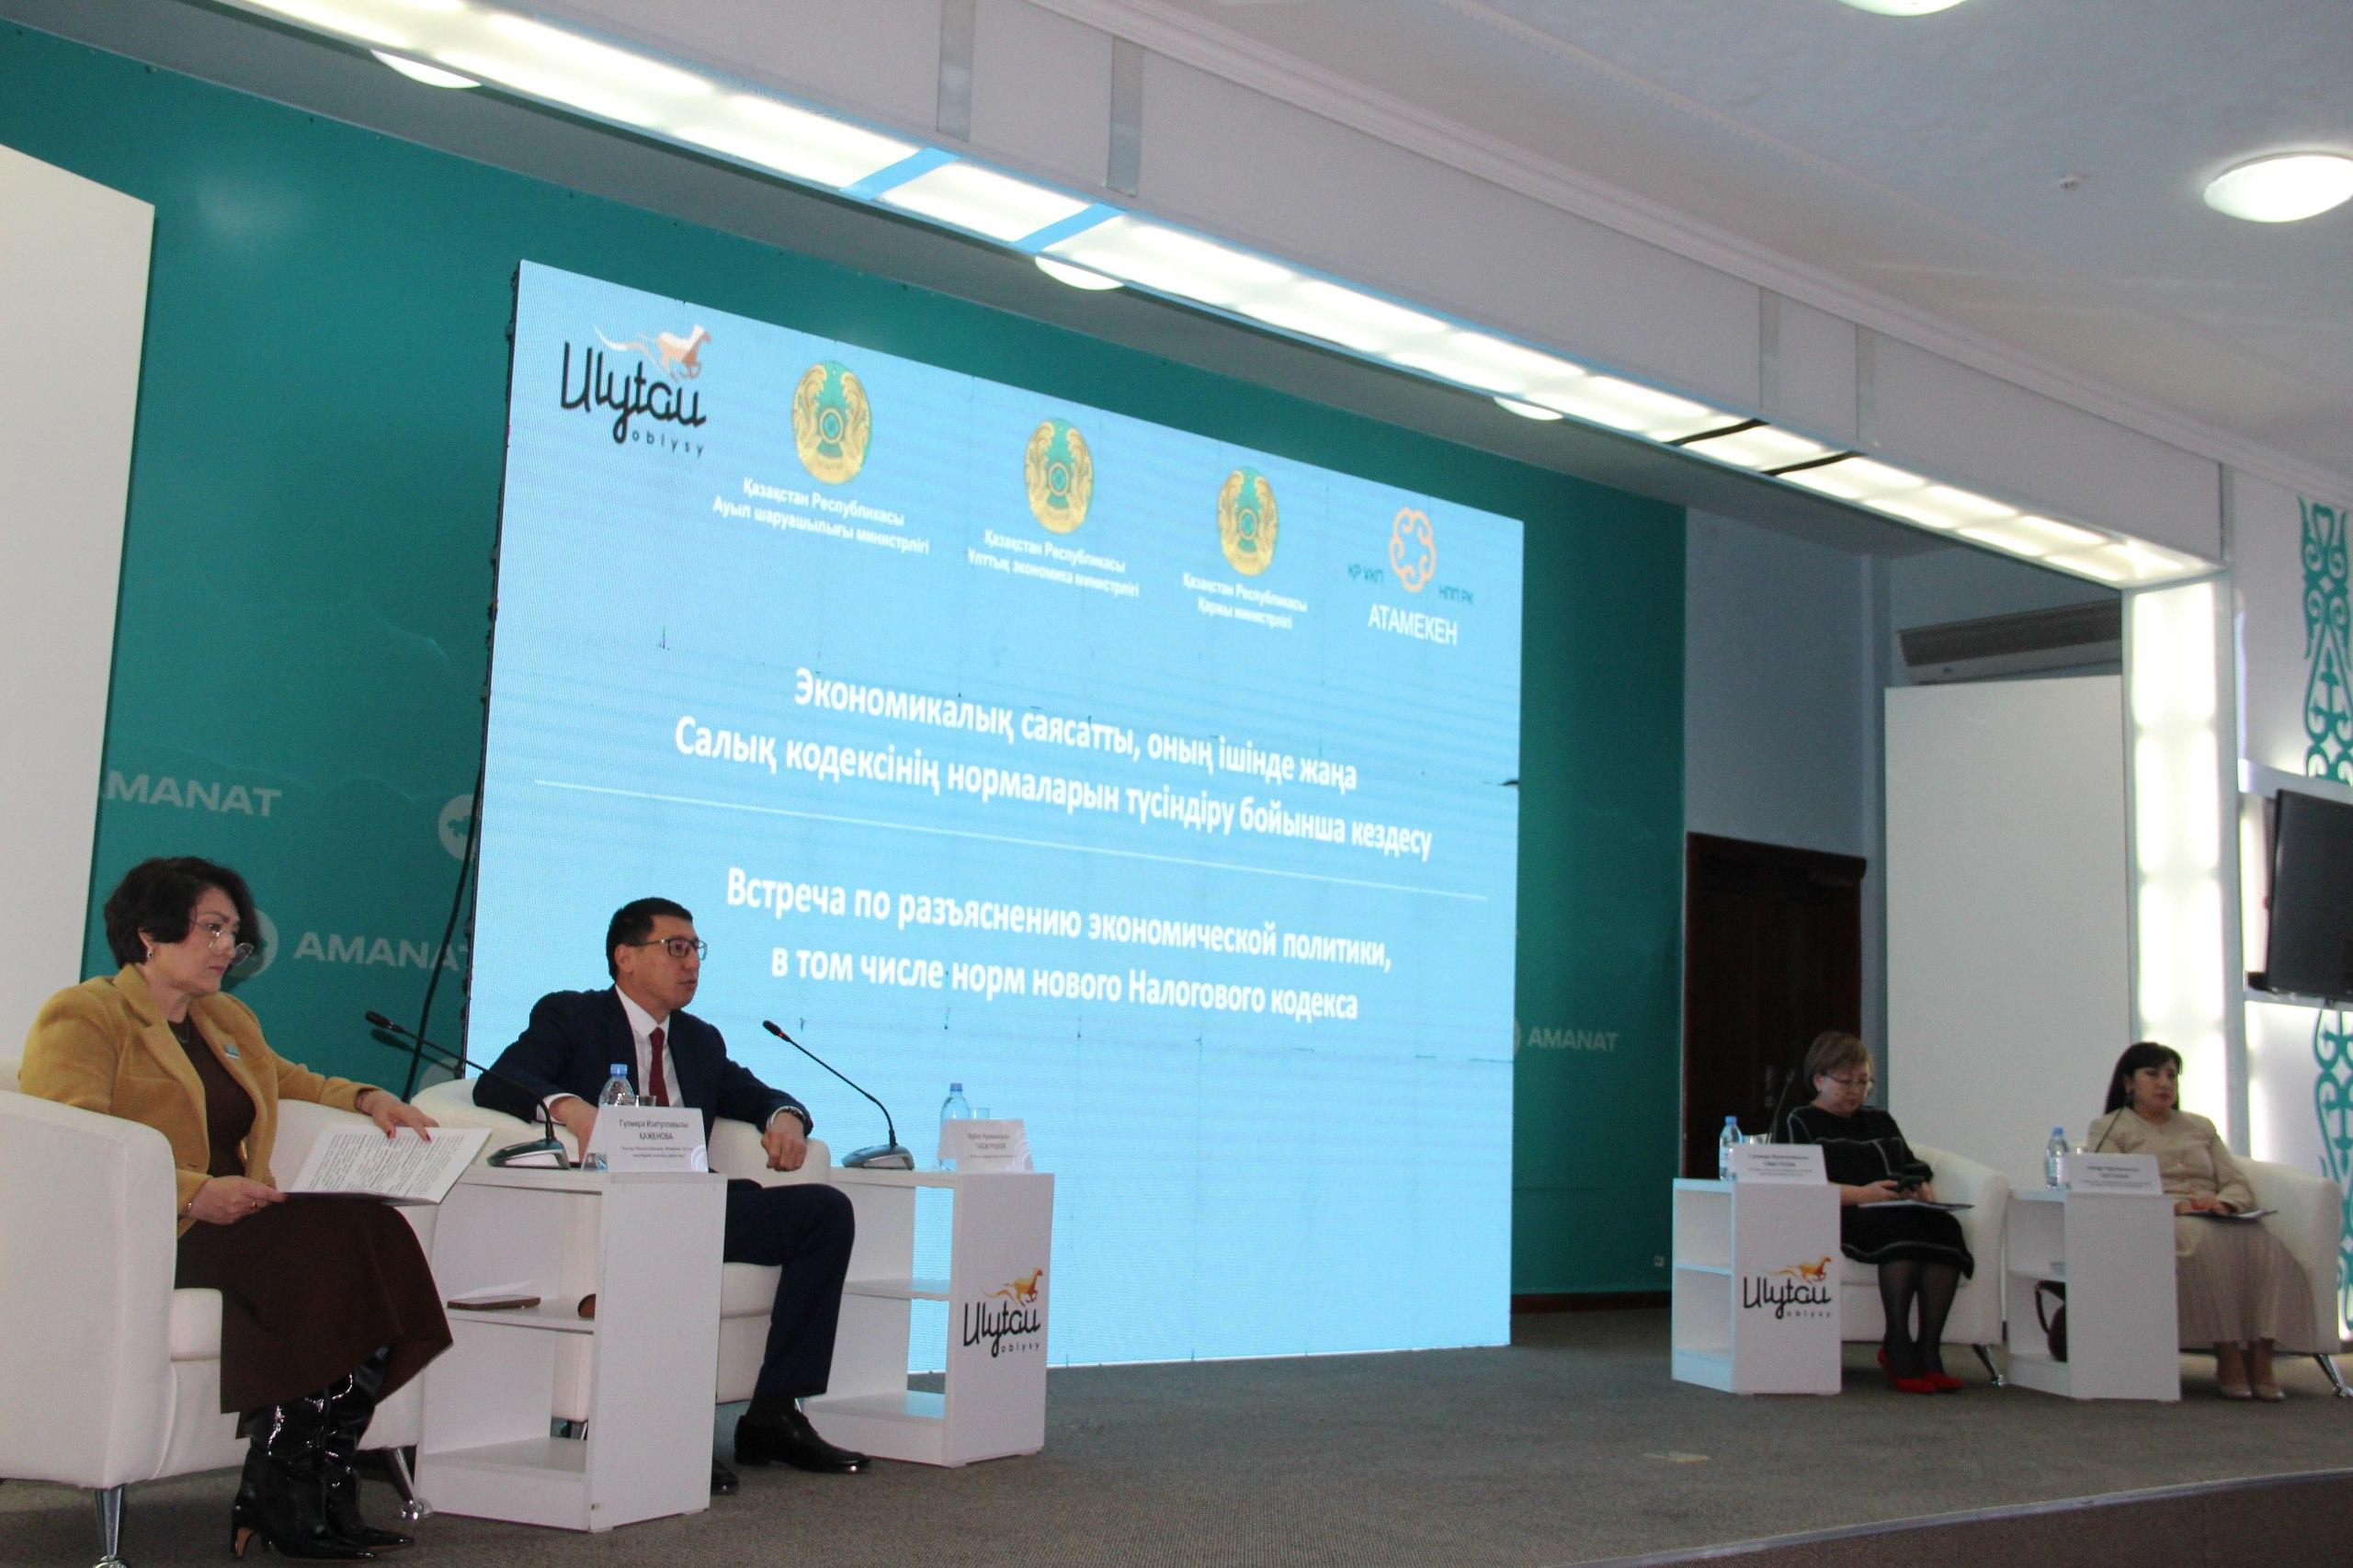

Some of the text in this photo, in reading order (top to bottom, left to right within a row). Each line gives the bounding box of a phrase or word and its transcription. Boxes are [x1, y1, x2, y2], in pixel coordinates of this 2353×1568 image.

[560, 342, 706, 444] Ulytau
[632, 430, 703, 458] oblysy
[712, 494, 929, 554] Ауыл шаруашылығы министрлігі
[743, 477, 904, 527] Қазақстан Республикасы
[984, 528, 1126, 574] Қазақстан Республикасы
[1013, 560, 1074, 585] экономика
[1074, 573, 1139, 597] министрлігі
[1368, 603, 1458, 646] АТАМЕКЕН
[794, 667, 1358, 795] Экономикалық саясатты, оның ішінде жаңа
[103, 769, 282, 817] MANAT
[675, 715, 1432, 862] Салық кодексінің нормаларын түсіндіру бойынша кездесу
[726, 867, 1392, 973] Встреча по разъяснению экономической политики,
[770, 946, 1358, 1024] в том числе норм нового Налогового кодекса
[1528, 1026, 1620, 1052] AMANAT
[1744, 1275, 1832, 1319] Ulytau
[1786, 1309, 1831, 1318] oblysy
[963, 1300, 1041, 1358] Ulytau
[1001, 1341, 1040, 1353] oblysy
